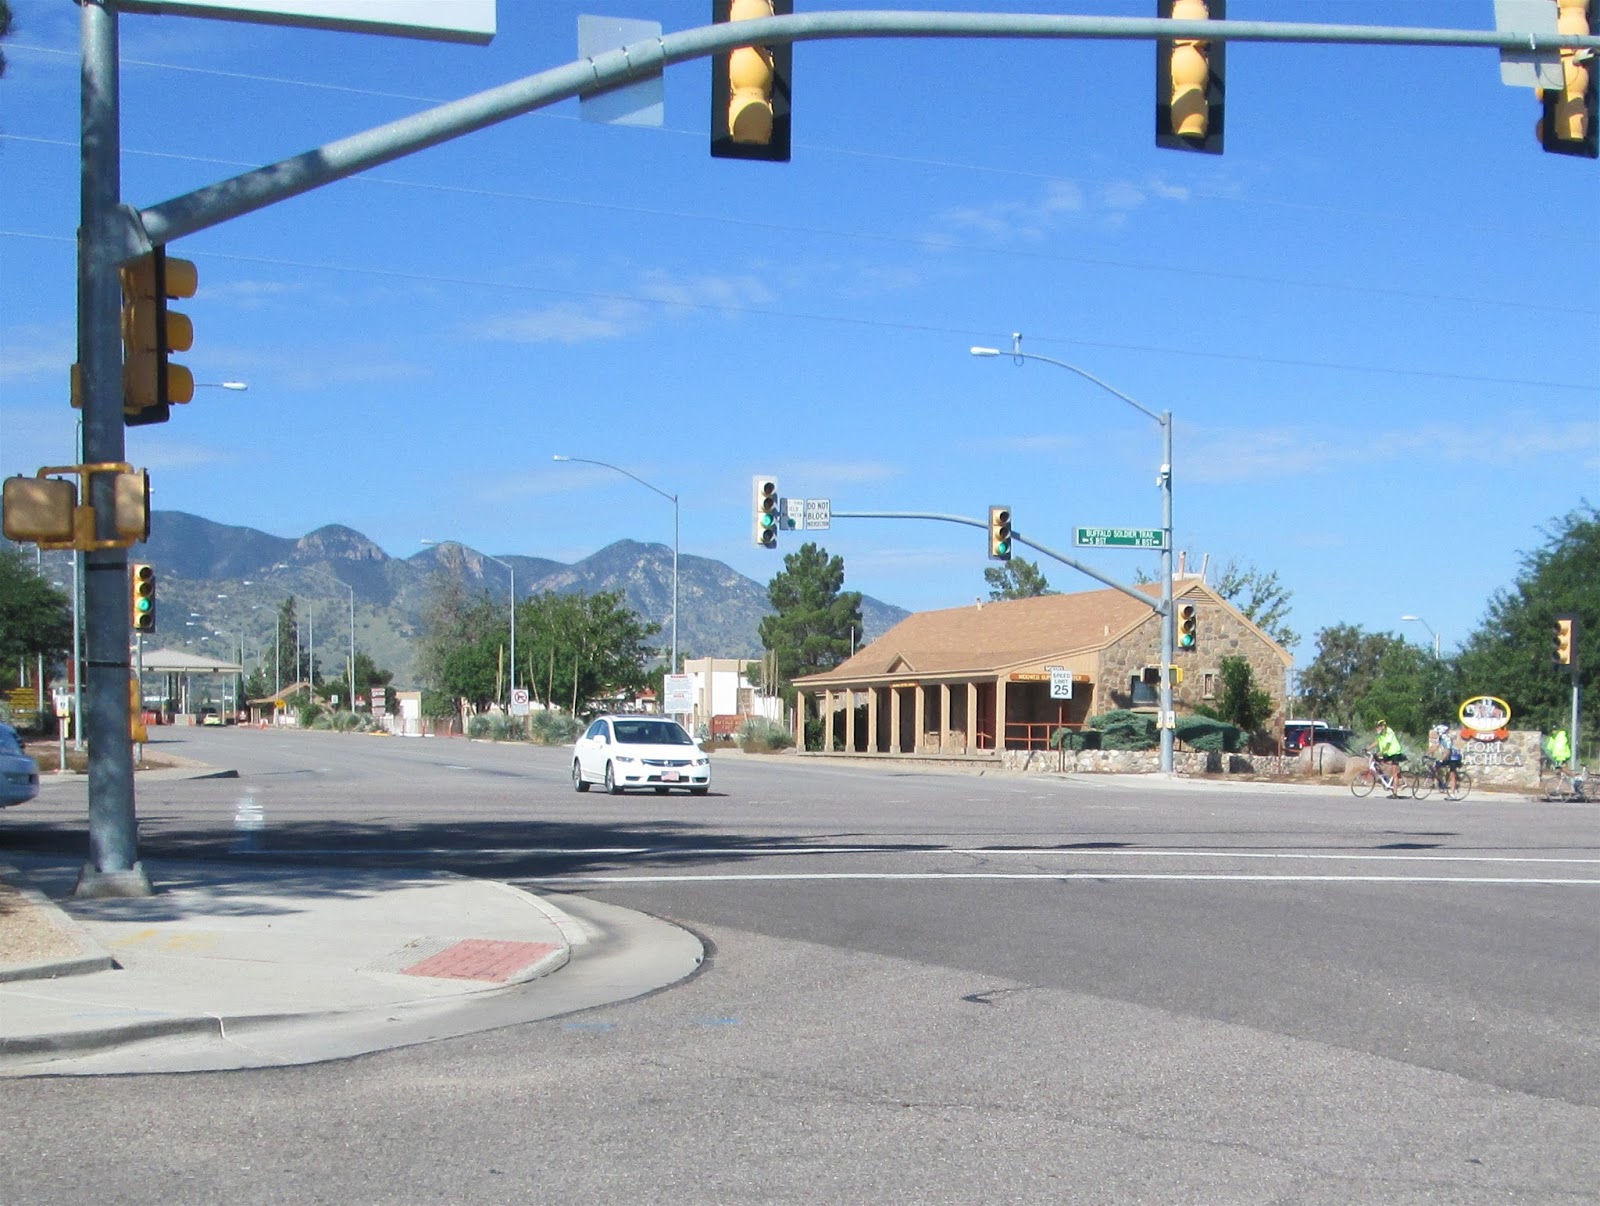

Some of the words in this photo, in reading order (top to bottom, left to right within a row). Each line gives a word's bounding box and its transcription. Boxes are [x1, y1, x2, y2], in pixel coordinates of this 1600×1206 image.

[1086, 529, 1112, 538] BUFFALO
[1113, 530, 1137, 538] SOLDIER
[1139, 531, 1155, 539] TRAIL
[1054, 684, 1069, 695] 25
[1466, 742, 1502, 753] FORT
[1461, 753, 1522, 766] ACHUCA
